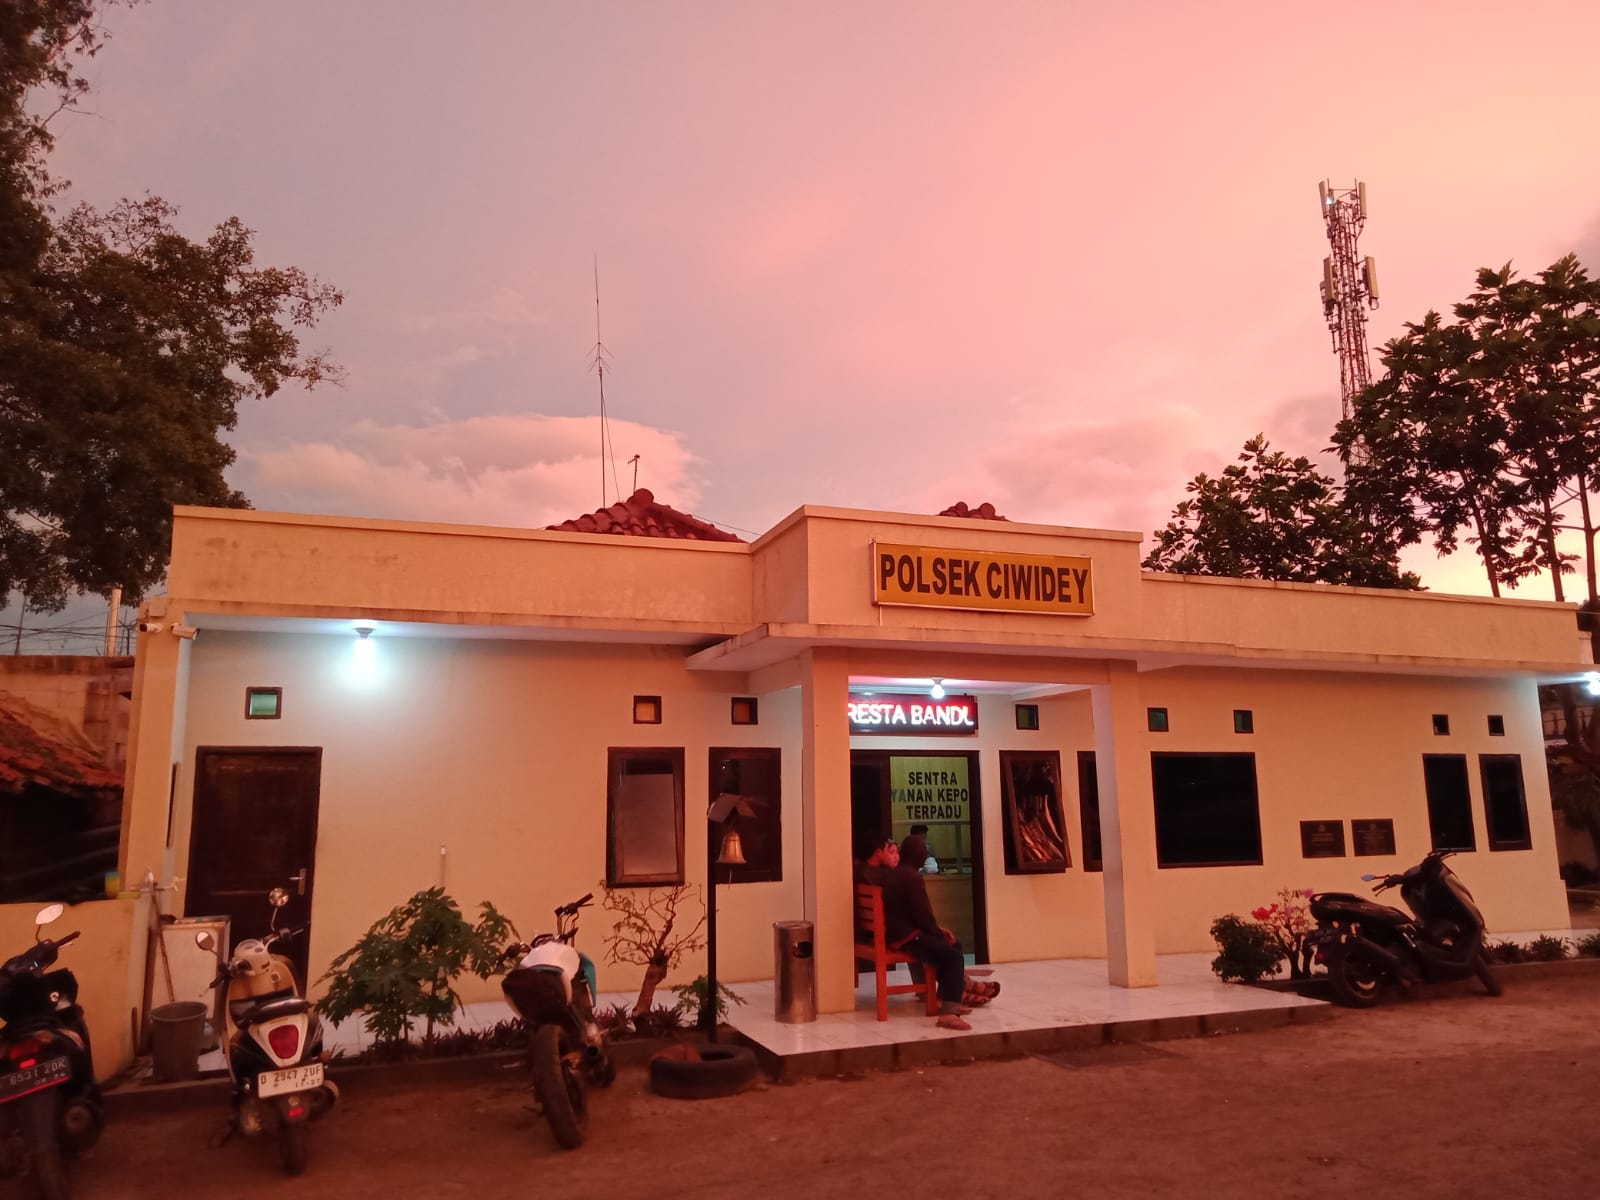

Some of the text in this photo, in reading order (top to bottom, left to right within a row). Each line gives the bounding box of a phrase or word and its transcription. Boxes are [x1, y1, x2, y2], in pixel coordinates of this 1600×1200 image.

[880, 553, 1089, 604] POLSEK CIWIDEY
[908, 771, 958, 786] SENTRA
[937, 788, 969, 803] KEPO
[906, 805, 962, 820] TERPADU
[303, 1065, 321, 1078] ZUF
